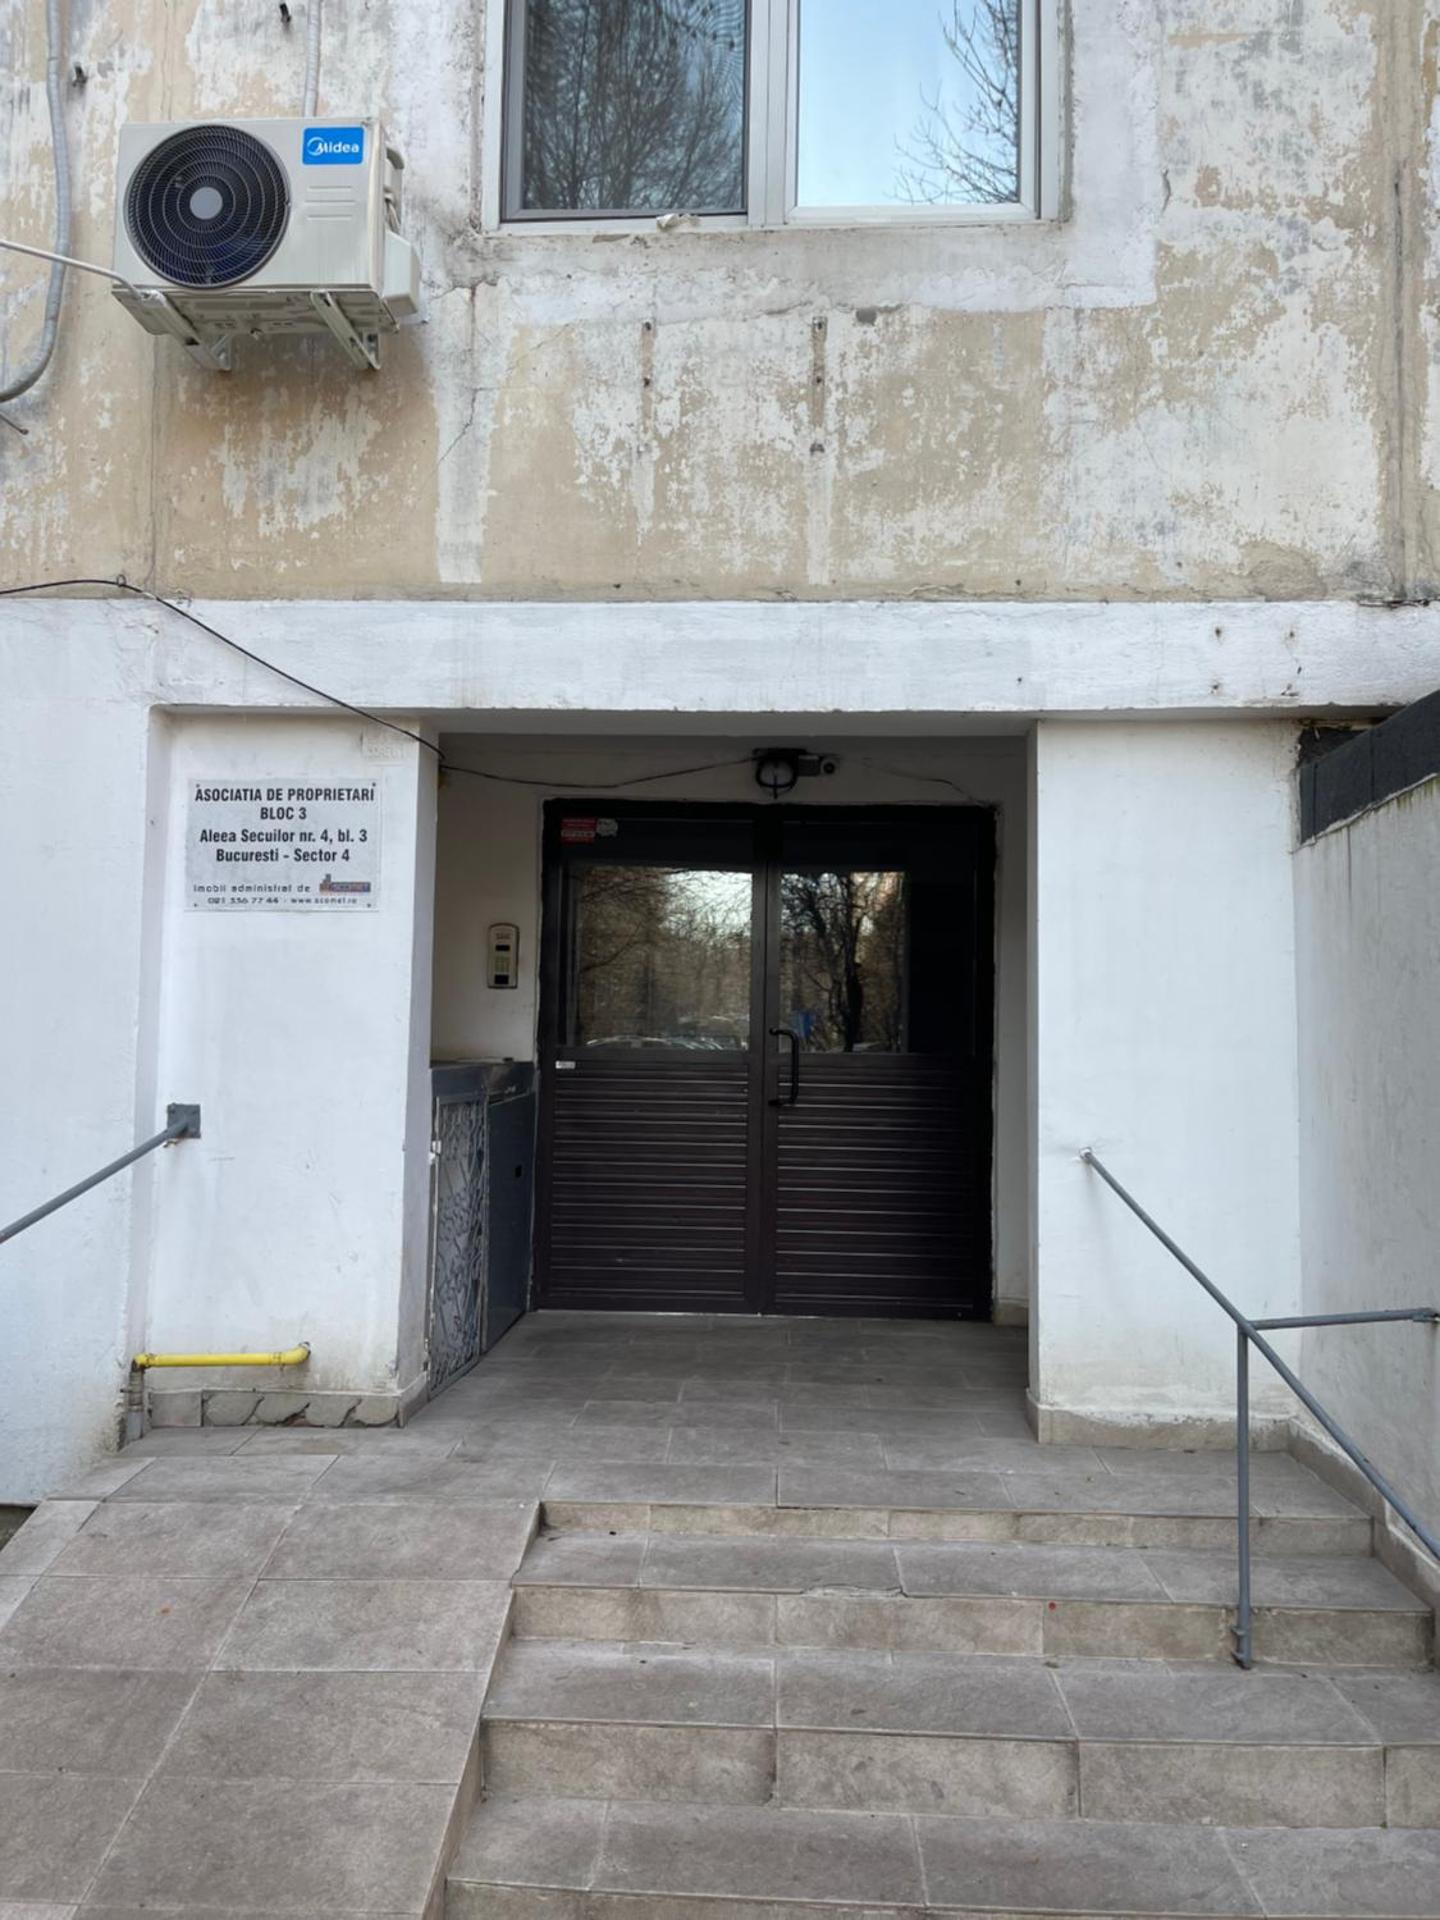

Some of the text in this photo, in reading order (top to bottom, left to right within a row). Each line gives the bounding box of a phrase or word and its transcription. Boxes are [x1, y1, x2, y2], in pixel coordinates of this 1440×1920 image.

[309, 138, 359, 155] Midea
[195, 787, 375, 801] ASOCIATIA DE PROPRIETARI
[260, 807, 307, 820] BLOC 3
[200, 829, 368, 845] Aleea Secuilor nr. 4, bl. 3
[216, 848, 279, 862] Bucuresti
[294, 848, 338, 862] Sector
[341, 848, 350, 862] 4
[231, 883, 292, 892] administrat
[297, 883, 310, 892] de
